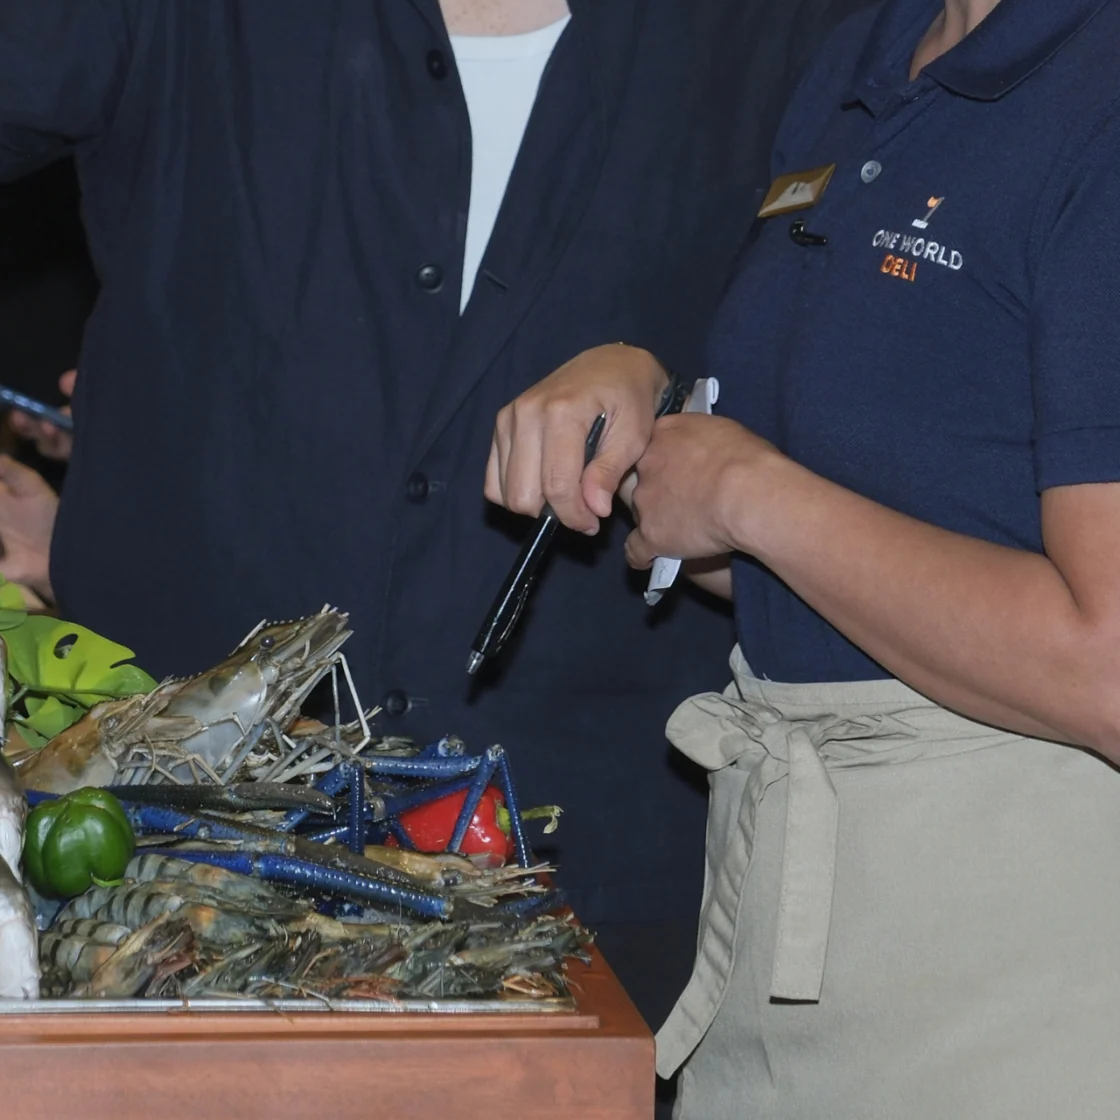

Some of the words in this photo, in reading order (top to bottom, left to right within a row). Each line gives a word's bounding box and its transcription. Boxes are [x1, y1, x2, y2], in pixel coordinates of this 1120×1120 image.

[872, 229, 899, 250] ONE
[900, 236, 963, 270] WORLD
[880, 254, 918, 282] DELI
